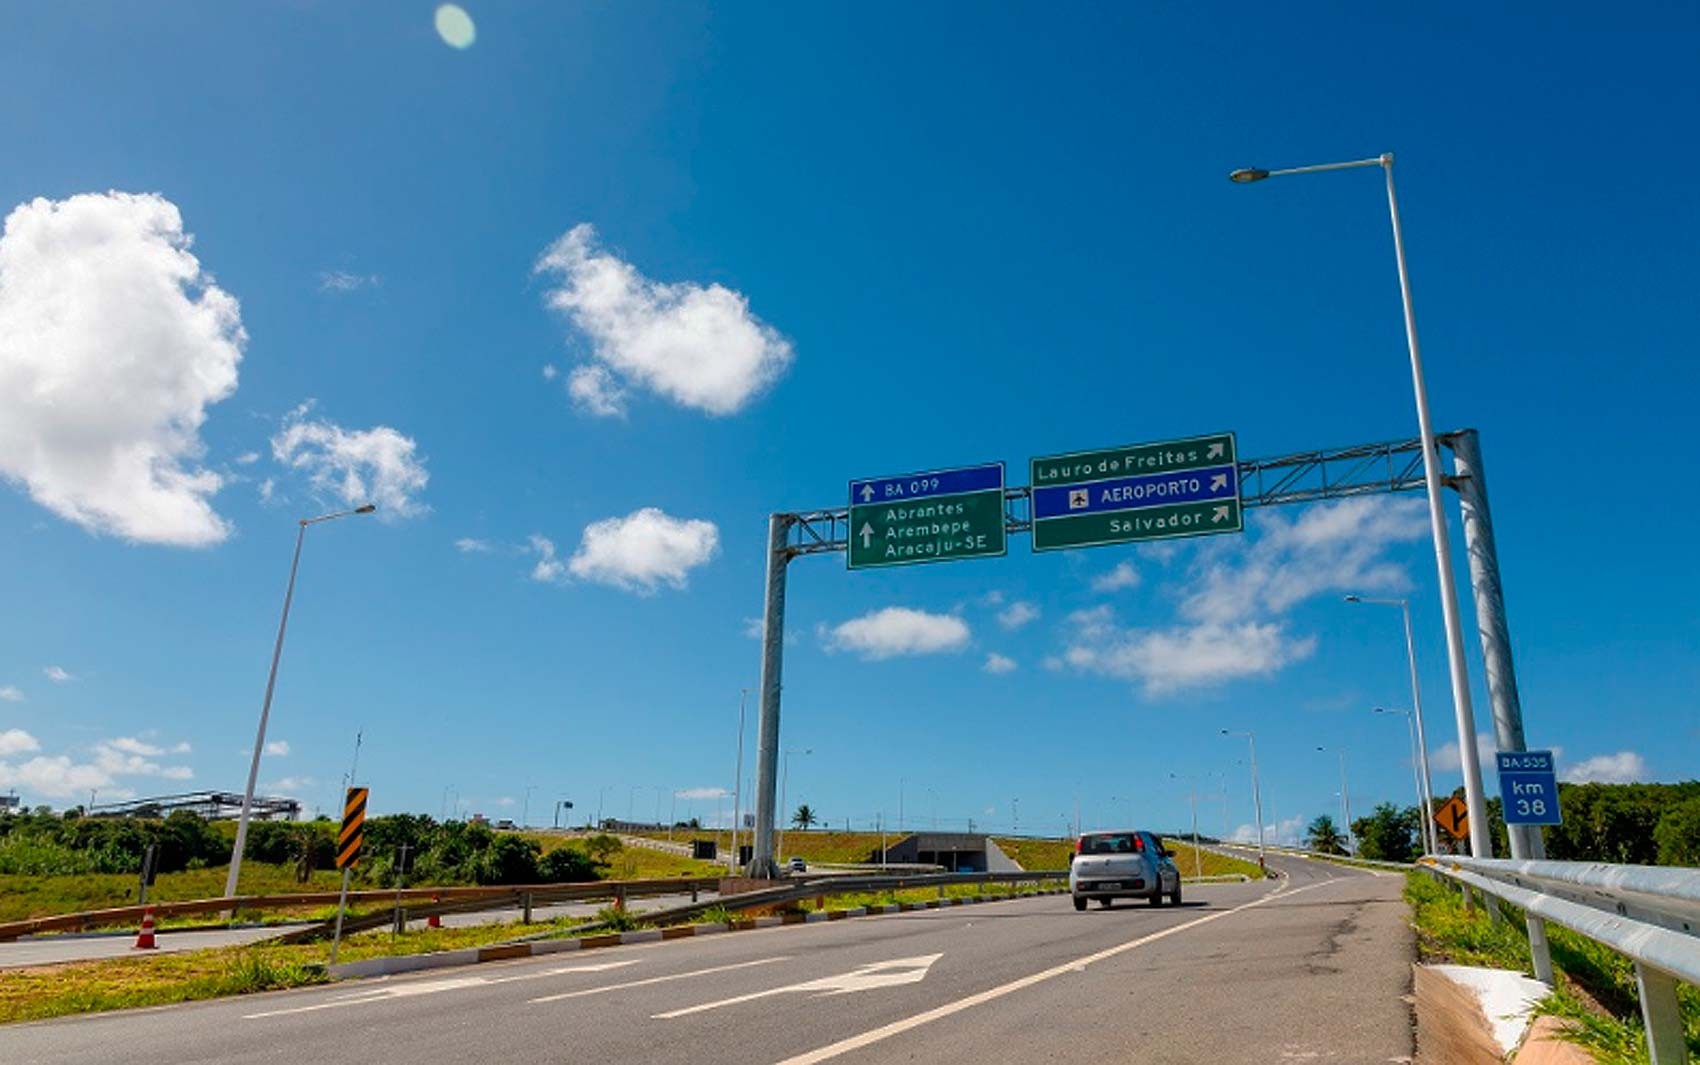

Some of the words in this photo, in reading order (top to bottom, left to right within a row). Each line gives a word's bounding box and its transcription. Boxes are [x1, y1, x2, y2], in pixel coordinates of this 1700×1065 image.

[1039, 464, 1092, 480] Lauro
[1098, 459, 1119, 473] de
[1125, 450, 1198, 469] Freitas
[885, 484, 903, 497] BA
[910, 478, 939, 494] 099
[1101, 479, 1200, 503] AEROPORTO
[886, 503, 964, 521] Abrantes
[885, 520, 970, 539] Arembepe
[1110, 512, 1202, 533] Salvador
[885, 535, 987, 557] Aracaju-SE
[1513, 780, 1544, 795] km
[1517, 799, 1546, 816] 38
